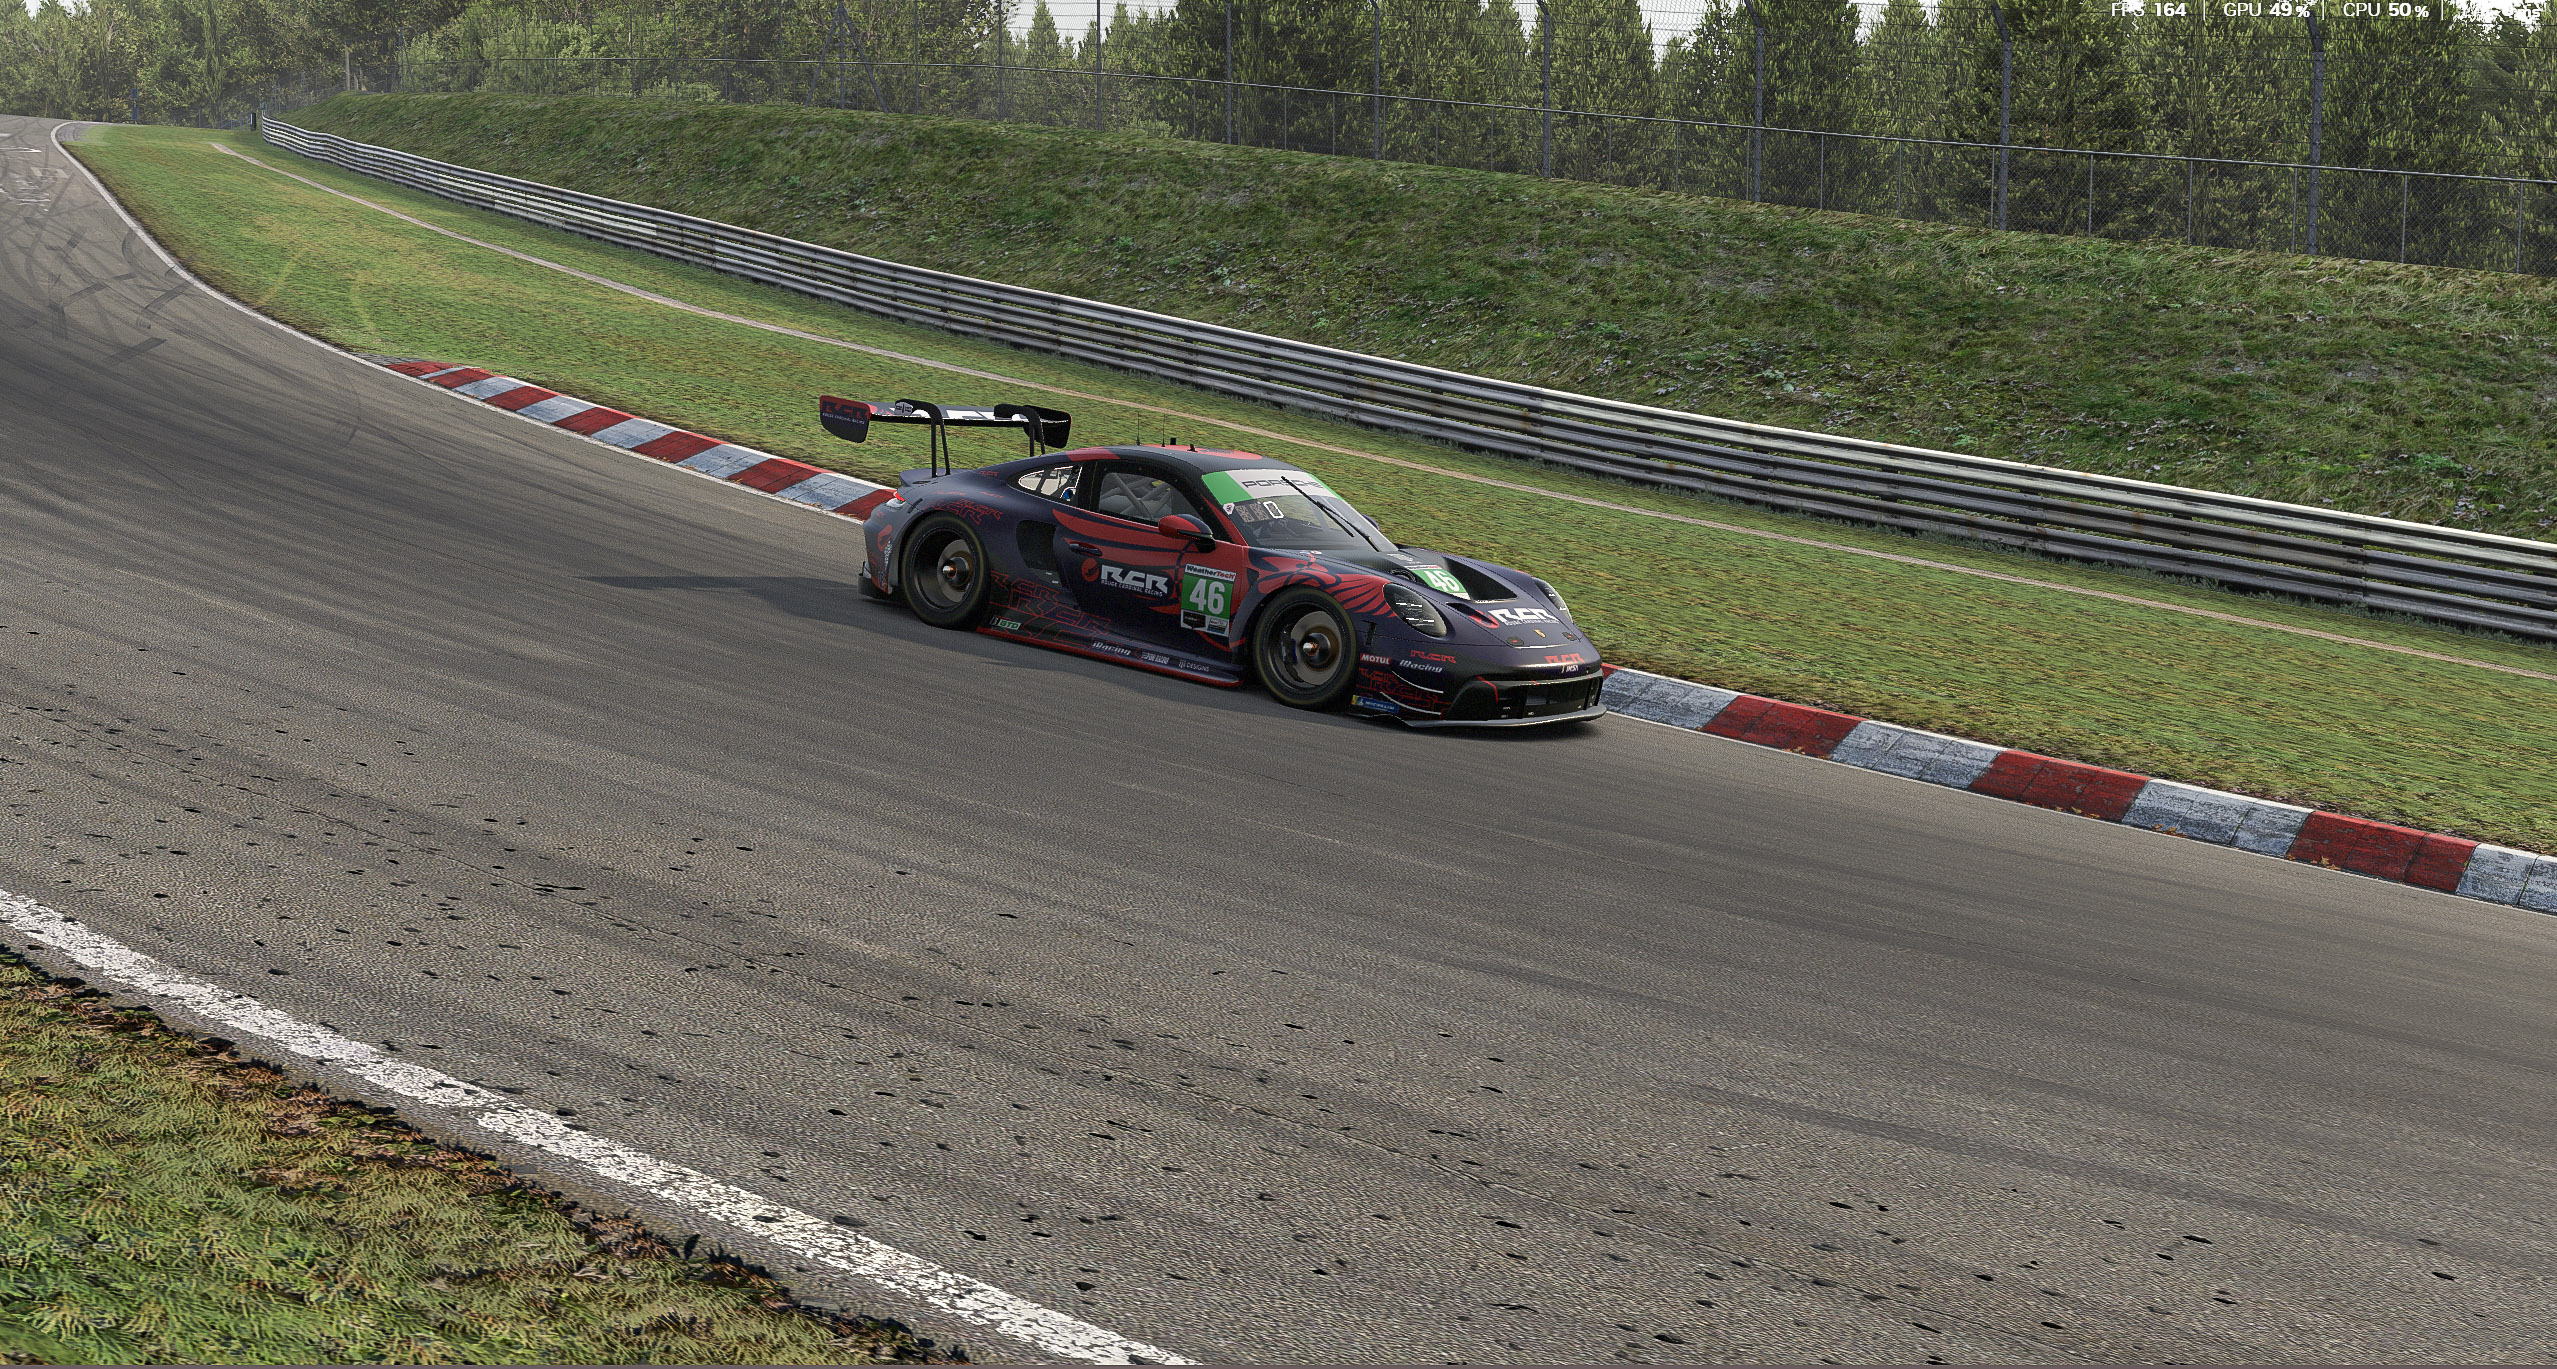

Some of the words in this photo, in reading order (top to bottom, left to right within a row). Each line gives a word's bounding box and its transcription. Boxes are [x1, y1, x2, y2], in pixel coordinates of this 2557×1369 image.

[1101, 564, 1168, 595] RCR
[1186, 564, 1236, 580] WeatherTech
[1423, 570, 1460, 592] 46
[1189, 578, 1225, 615] 46
[1092, 641, 1132, 656] iRacing
[1361, 654, 1391, 665] MOTUL
[1399, 659, 1443, 673] iRacing
